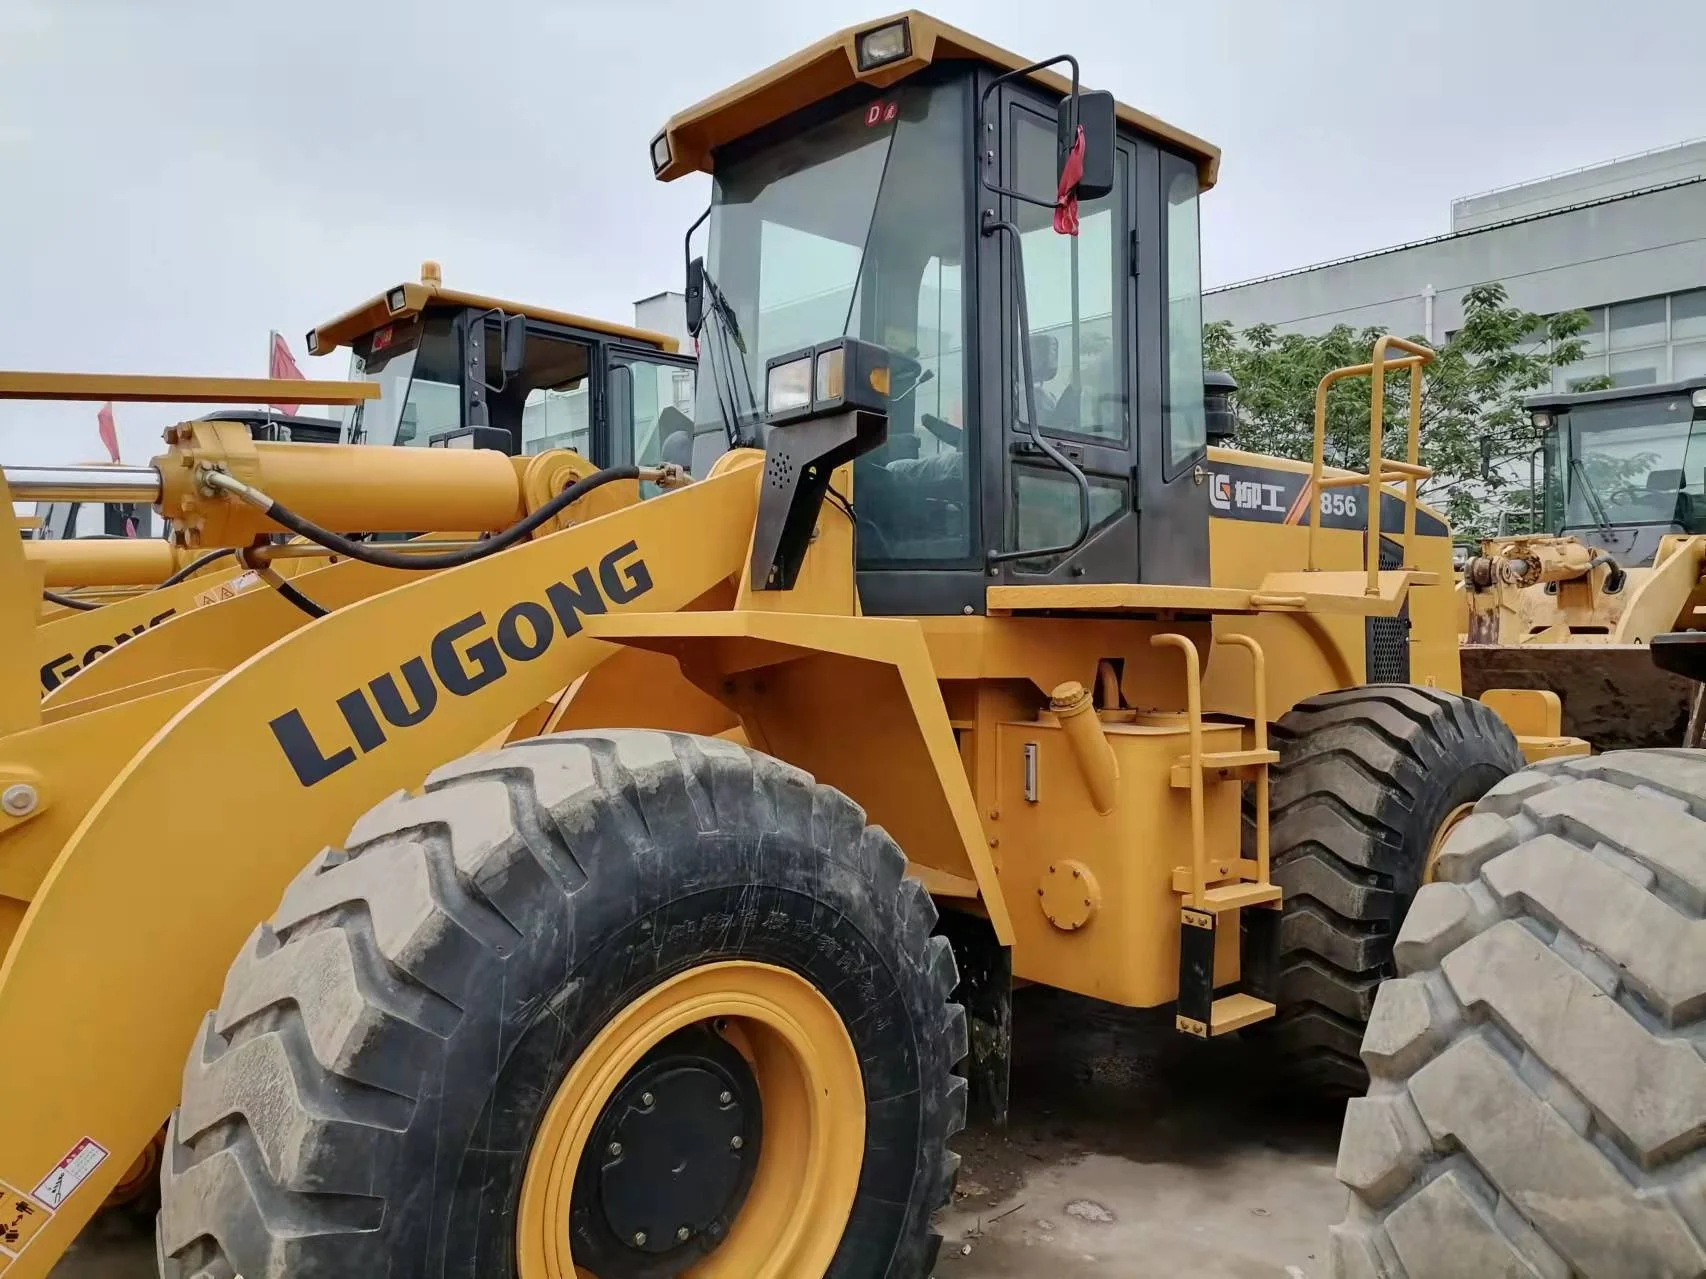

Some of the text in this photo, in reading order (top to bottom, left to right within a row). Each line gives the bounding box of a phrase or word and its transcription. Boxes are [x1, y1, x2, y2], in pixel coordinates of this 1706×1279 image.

[1234, 480, 1286, 513] 柳工
[1320, 492, 1357, 518] 856
[267, 539, 654, 788] LIUGONG
